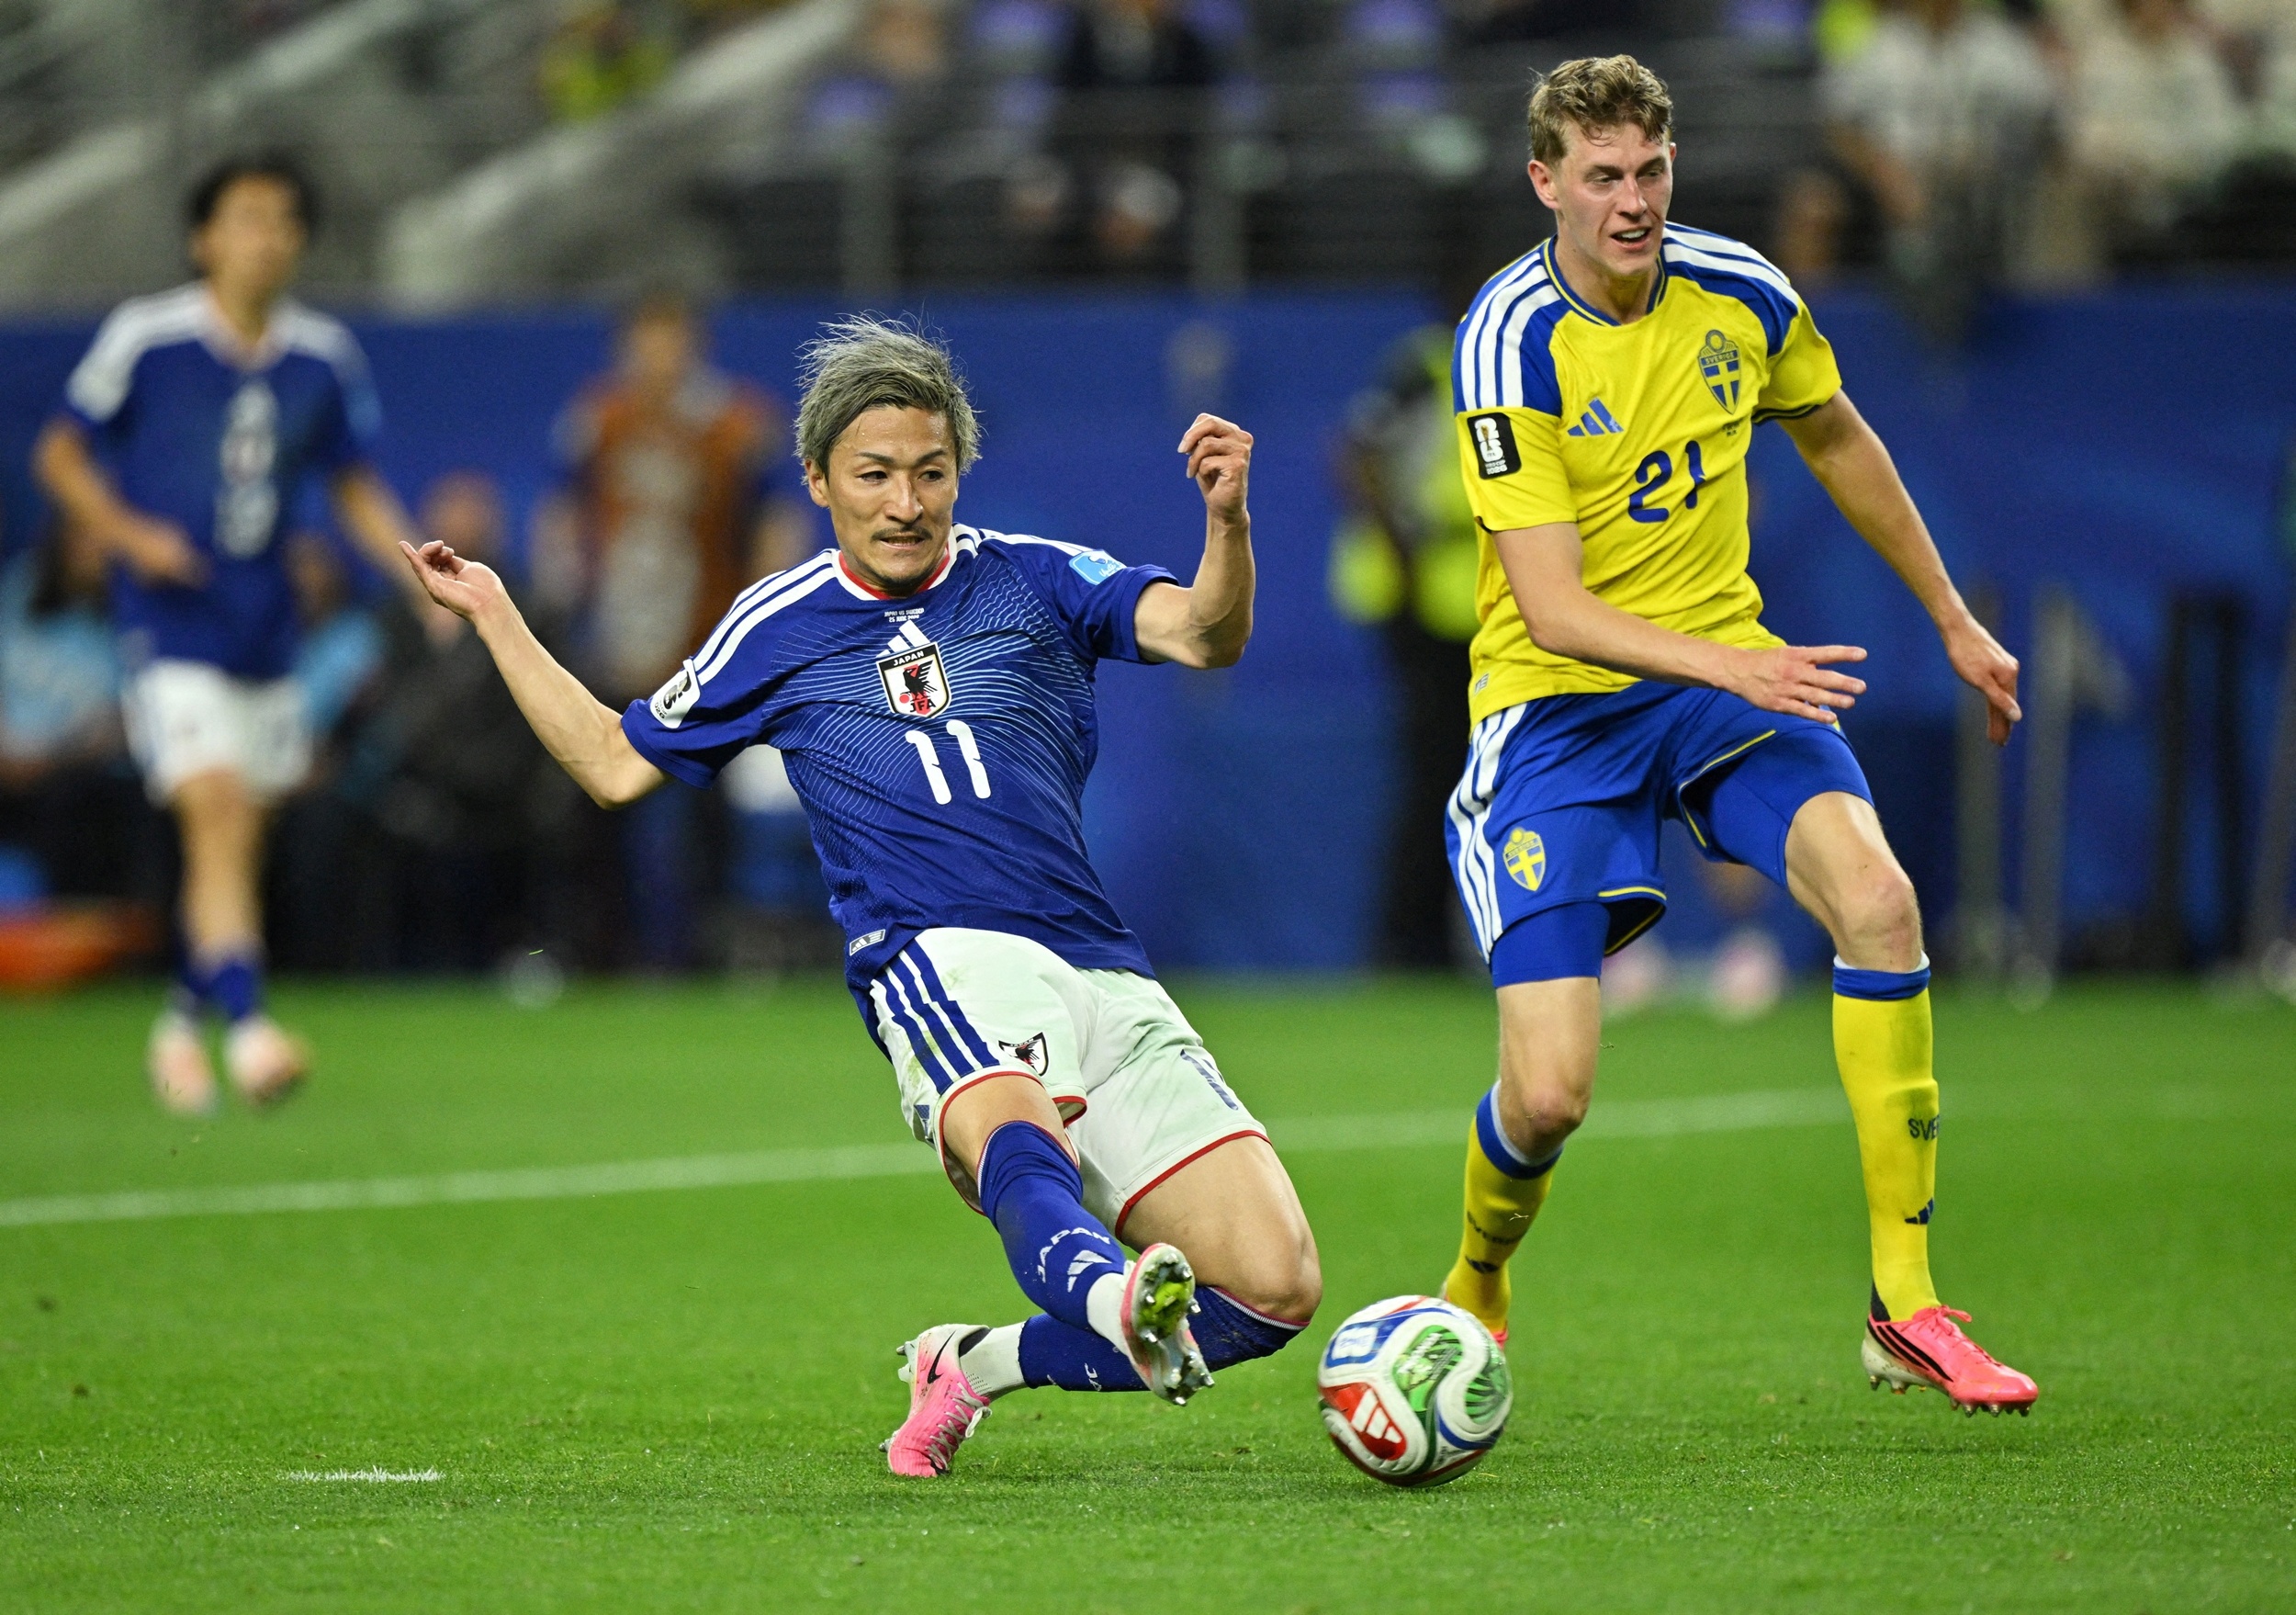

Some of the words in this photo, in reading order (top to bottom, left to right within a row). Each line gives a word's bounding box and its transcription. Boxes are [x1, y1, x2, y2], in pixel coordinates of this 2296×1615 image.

[1628, 440, 1705, 523] 21
[894, 650, 925, 666] JAPAN
[909, 698, 937, 713] JFA
[905, 719, 991, 805] 11
[1037, 1227, 1111, 1283] JAPAN
